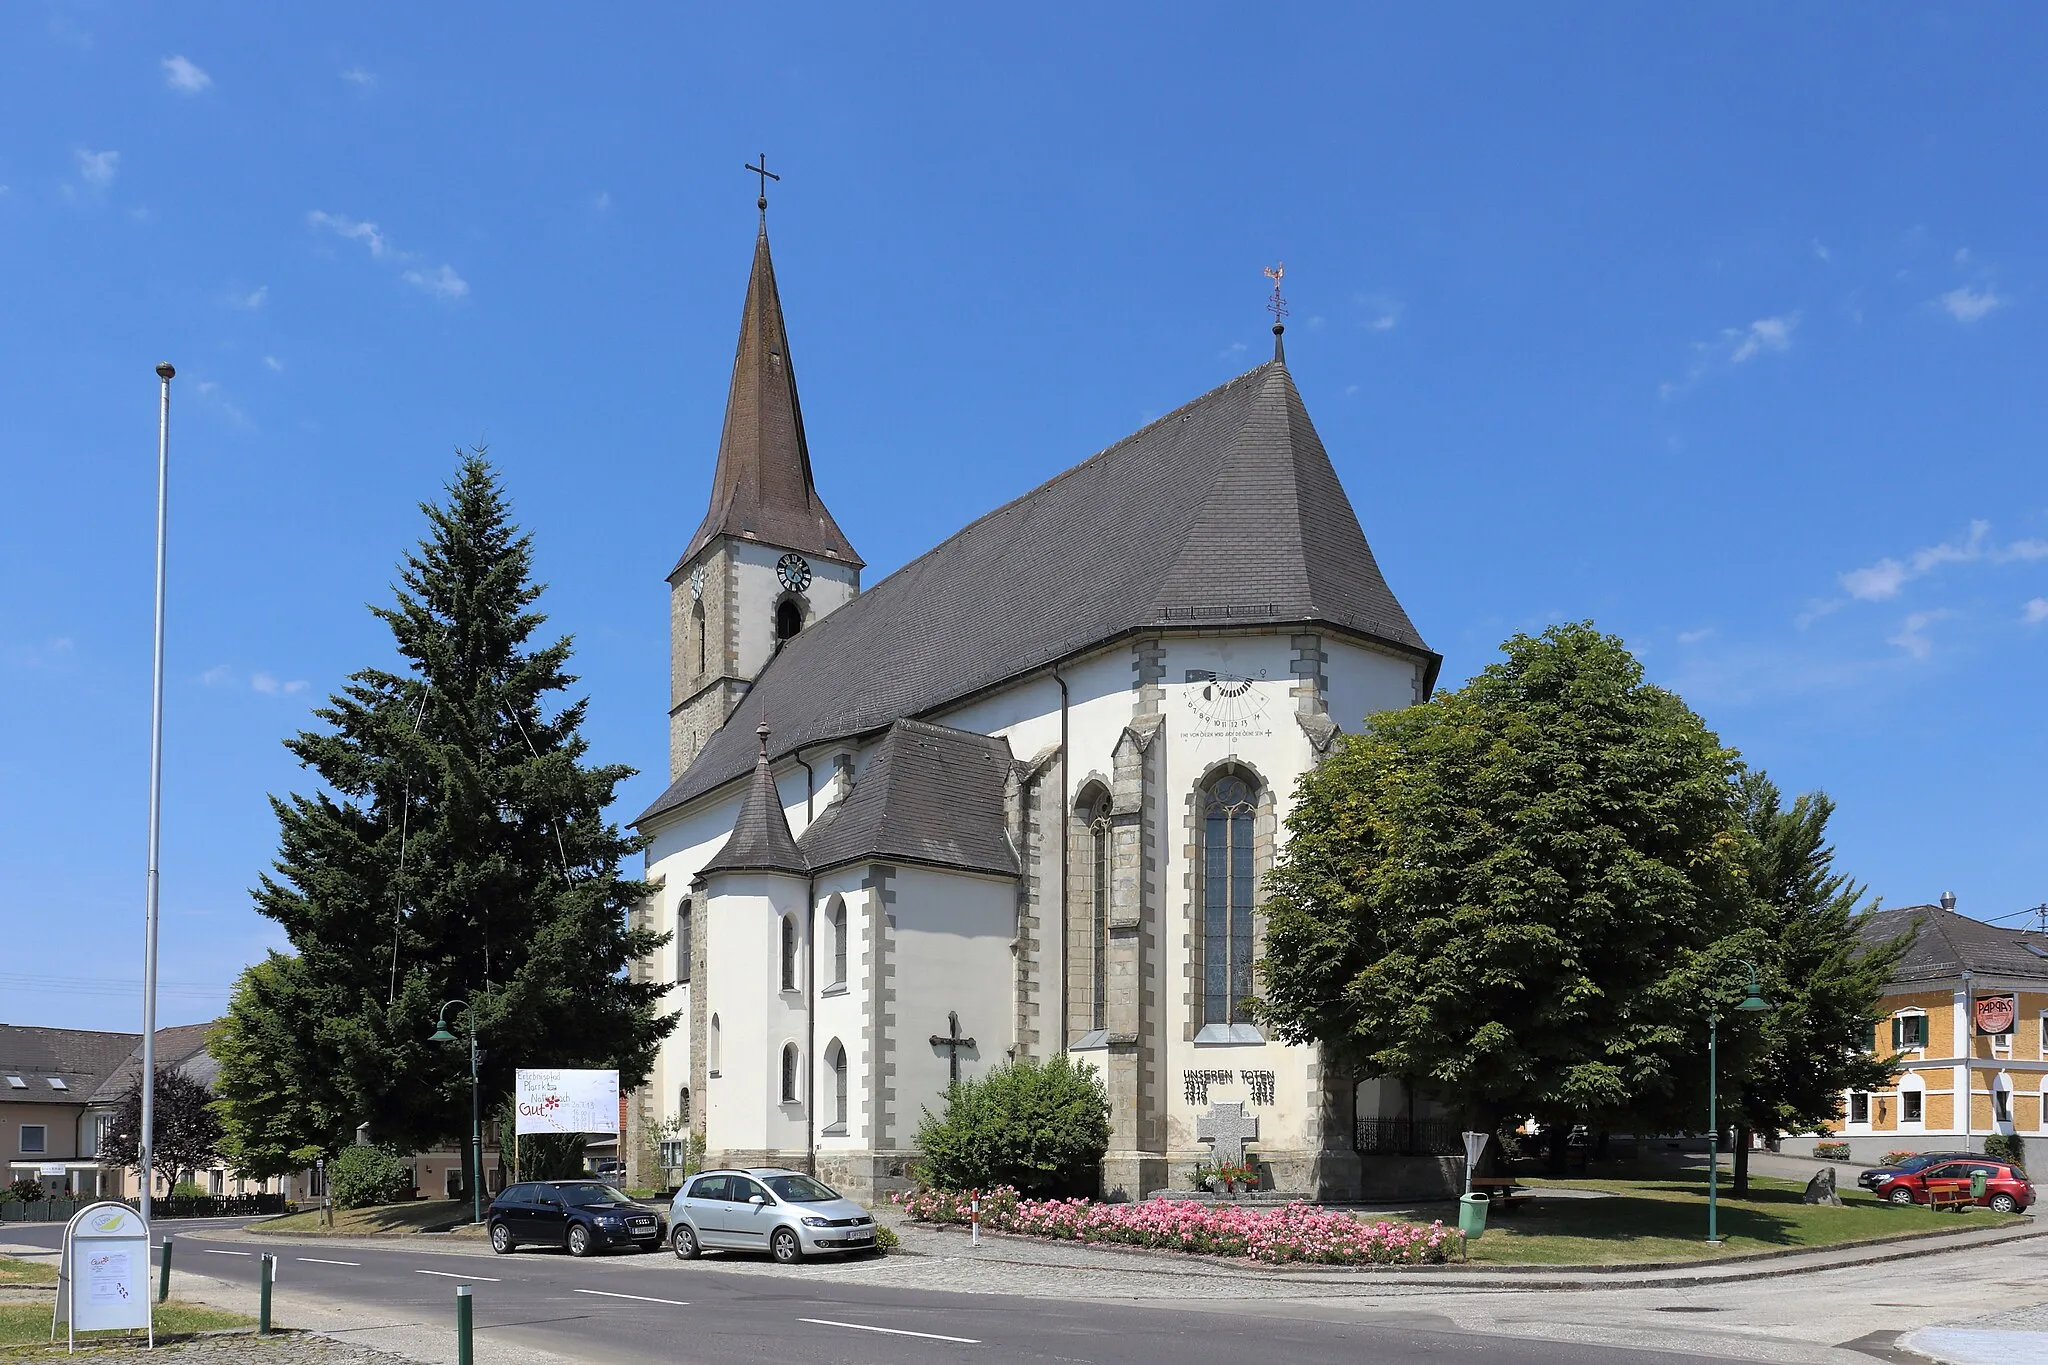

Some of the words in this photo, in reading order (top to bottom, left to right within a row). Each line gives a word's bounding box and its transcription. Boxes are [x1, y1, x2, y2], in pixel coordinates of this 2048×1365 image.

[1183, 1070, 1233, 1080] UNSEREN
[1240, 1070, 1274, 1080] TOTEN
[1184, 1092, 1207, 1102] 1918
[1250, 1092, 1274, 1102] 1945
